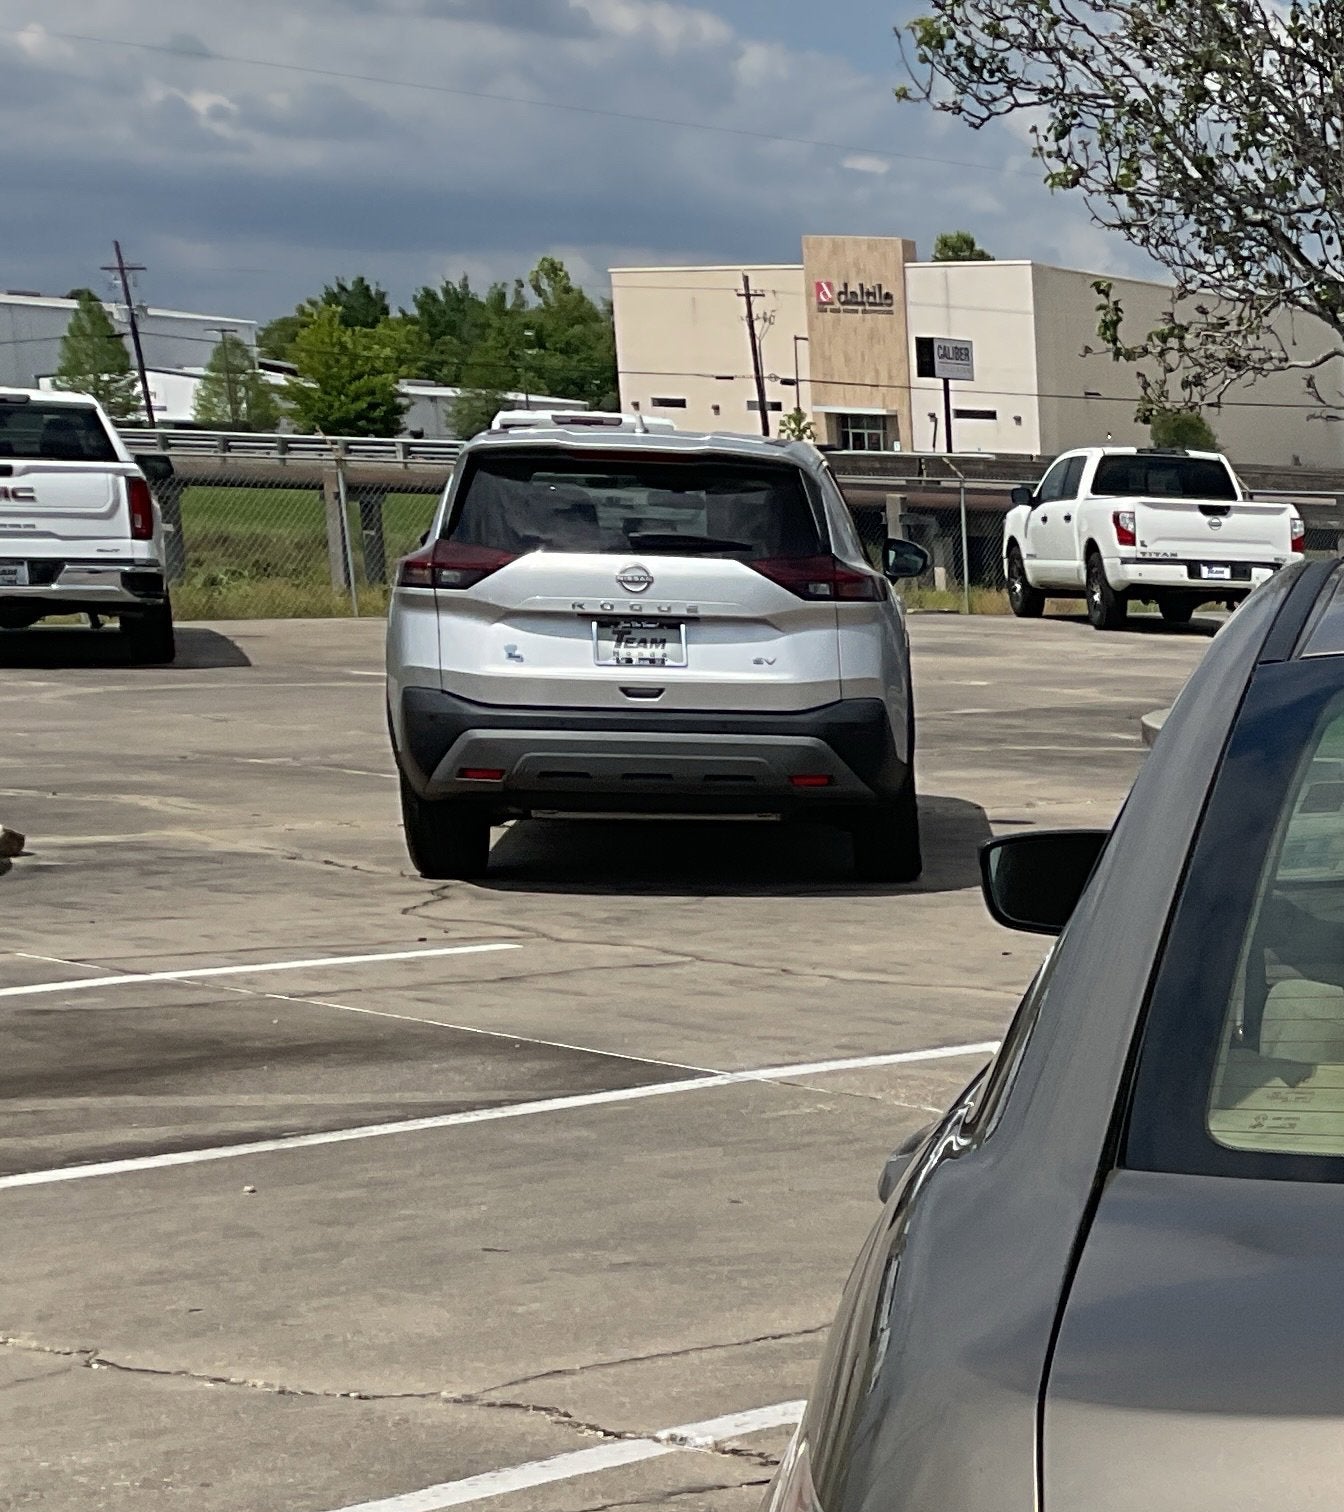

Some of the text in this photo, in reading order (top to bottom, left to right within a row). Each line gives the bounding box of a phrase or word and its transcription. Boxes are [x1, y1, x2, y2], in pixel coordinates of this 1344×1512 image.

[838, 281, 894, 307] daltile
[937, 344, 971, 362] CALIBER
[571, 601, 699, 614] ROGUE
[611, 629, 667, 650] TEAM
[752, 657, 777, 666] SV
